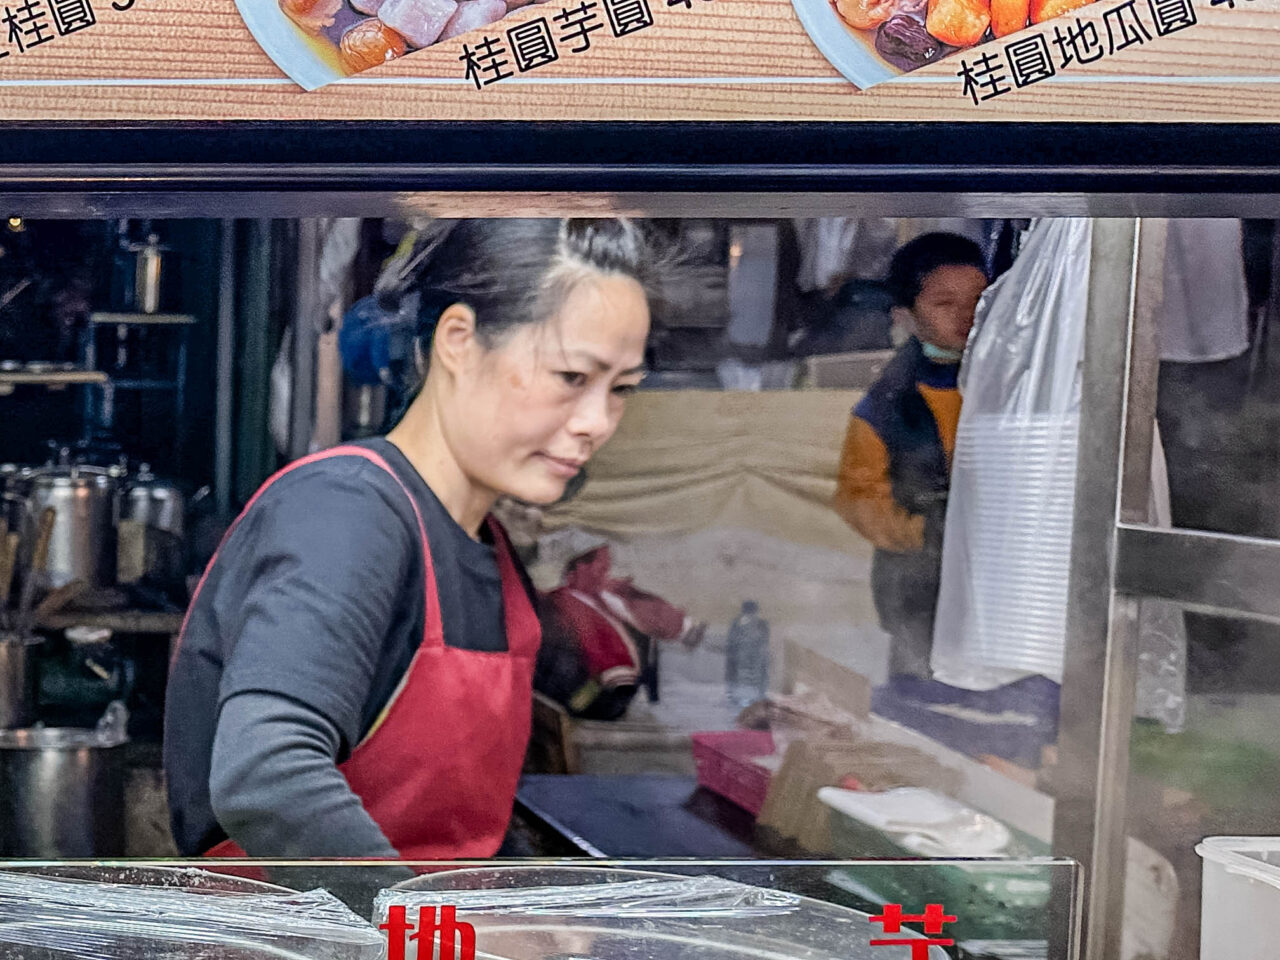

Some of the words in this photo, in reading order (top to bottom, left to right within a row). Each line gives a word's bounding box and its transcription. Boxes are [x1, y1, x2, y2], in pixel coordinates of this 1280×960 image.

[459, 0, 654, 90] 桂圓芋圓
[957, 0, 1198, 105] 桂圓地瓜圓
